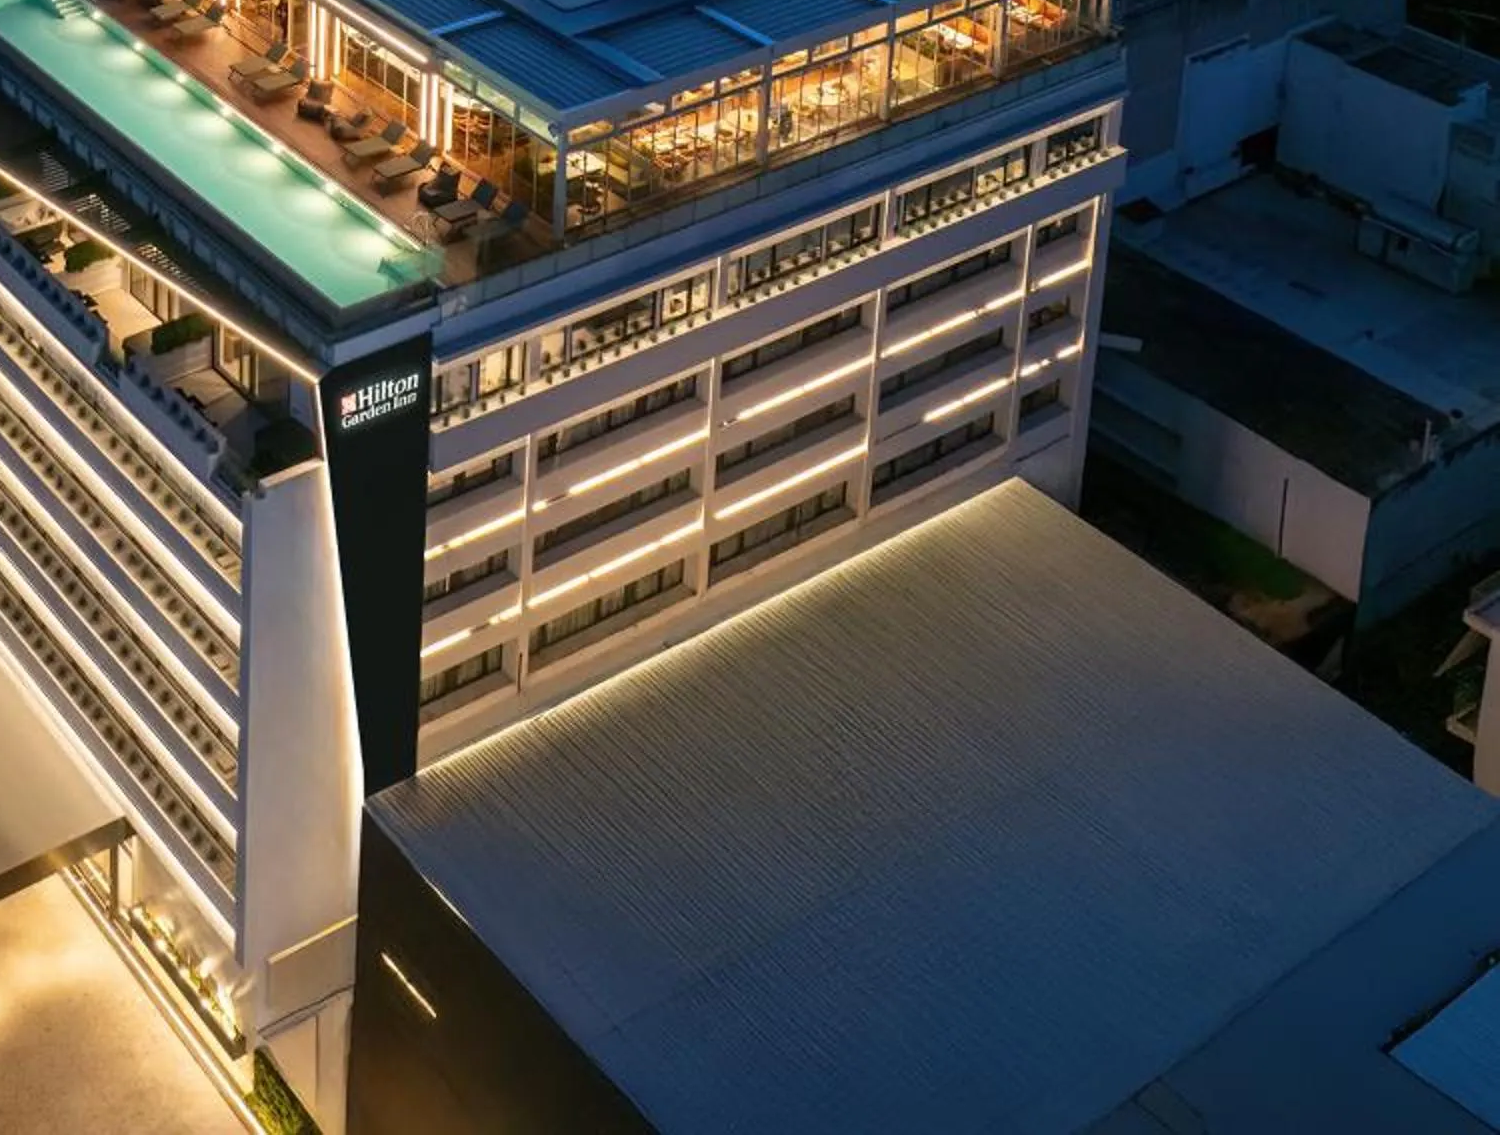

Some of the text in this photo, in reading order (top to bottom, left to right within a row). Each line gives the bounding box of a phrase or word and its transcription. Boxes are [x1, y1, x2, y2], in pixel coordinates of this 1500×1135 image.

[357, 373, 419, 409] Hilton
[342, 392, 417, 428] Garden Inn
